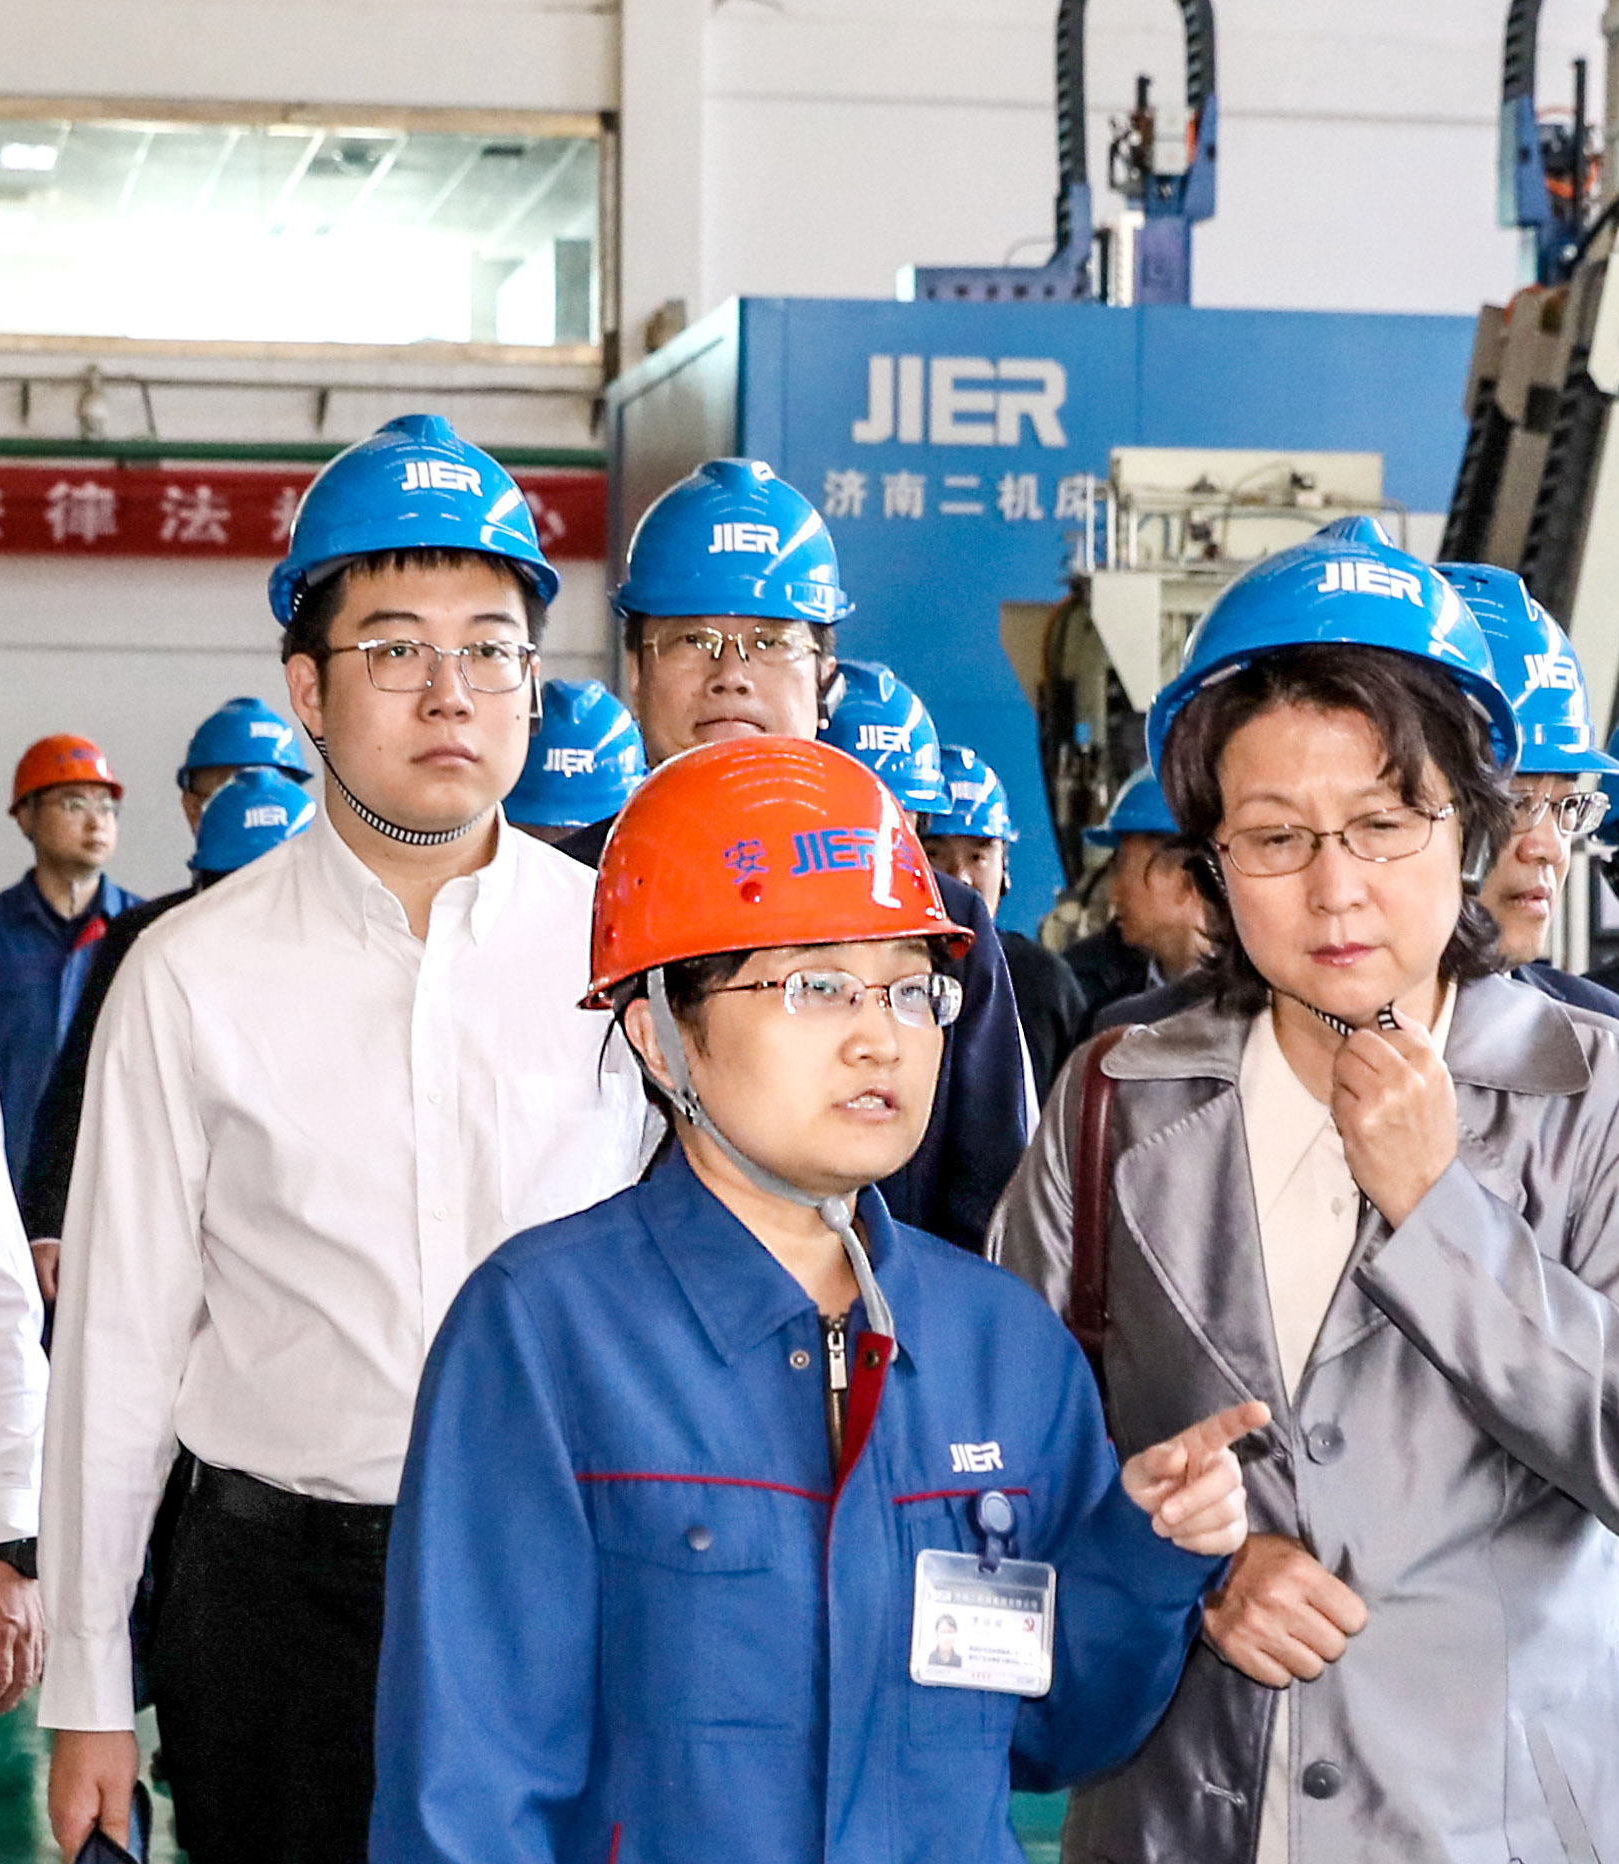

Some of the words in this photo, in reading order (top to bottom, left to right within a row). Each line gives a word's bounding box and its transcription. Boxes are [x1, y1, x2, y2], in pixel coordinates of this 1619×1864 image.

[852, 355, 1068, 447] JIER
[401, 461, 484, 497] JIER
[708, 522, 780, 557] JIER
[1317, 562, 1425, 607] JIER
[1524, 654, 1581, 691] JIER
[856, 725, 911, 753] JIER
[543, 748, 594, 773] JIER
[244, 805, 289, 829] JIER
[950, 1441, 1004, 1473] JIER
